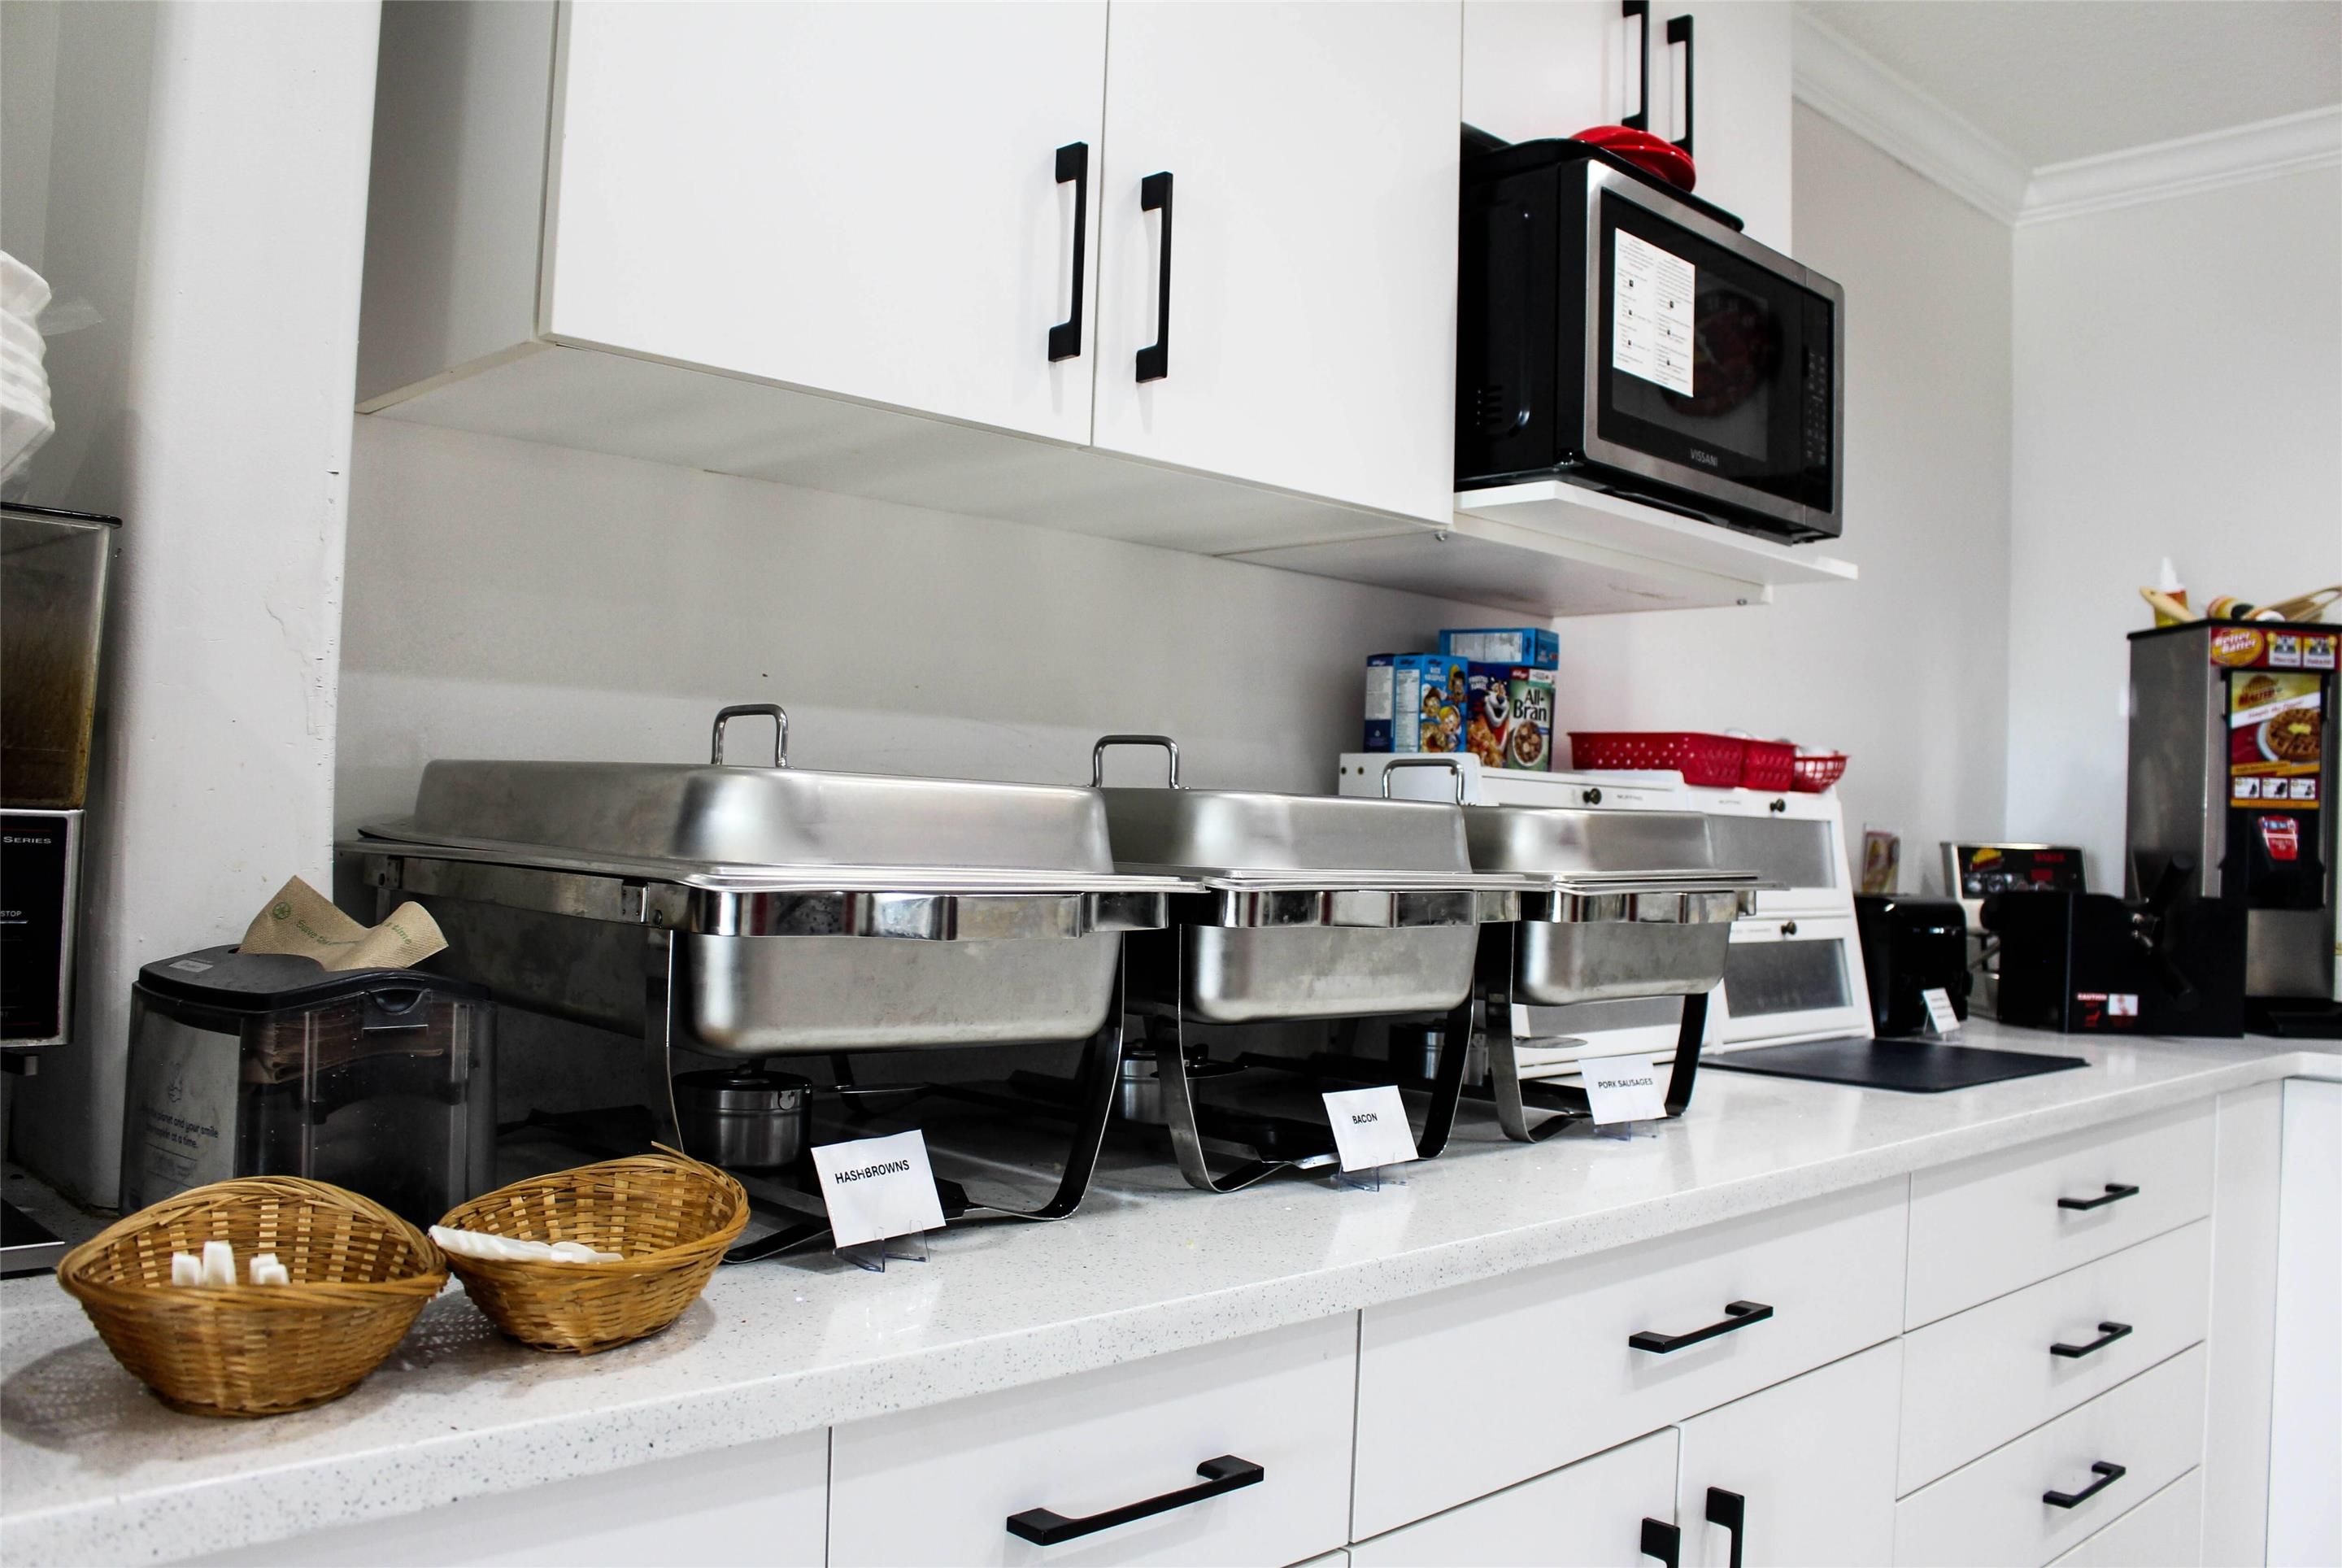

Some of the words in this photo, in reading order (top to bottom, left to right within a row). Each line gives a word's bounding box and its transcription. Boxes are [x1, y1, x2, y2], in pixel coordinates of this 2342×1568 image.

[1525, 689, 1545, 706] All-
[1513, 699, 1548, 721] Bran
[1598, 1080, 1616, 1089] PORK
[1617, 1078, 1653, 1088] SAUSAGES
[1352, 1113, 1378, 1125] BACON
[834, 1159, 910, 1184] HASHBROWNS
